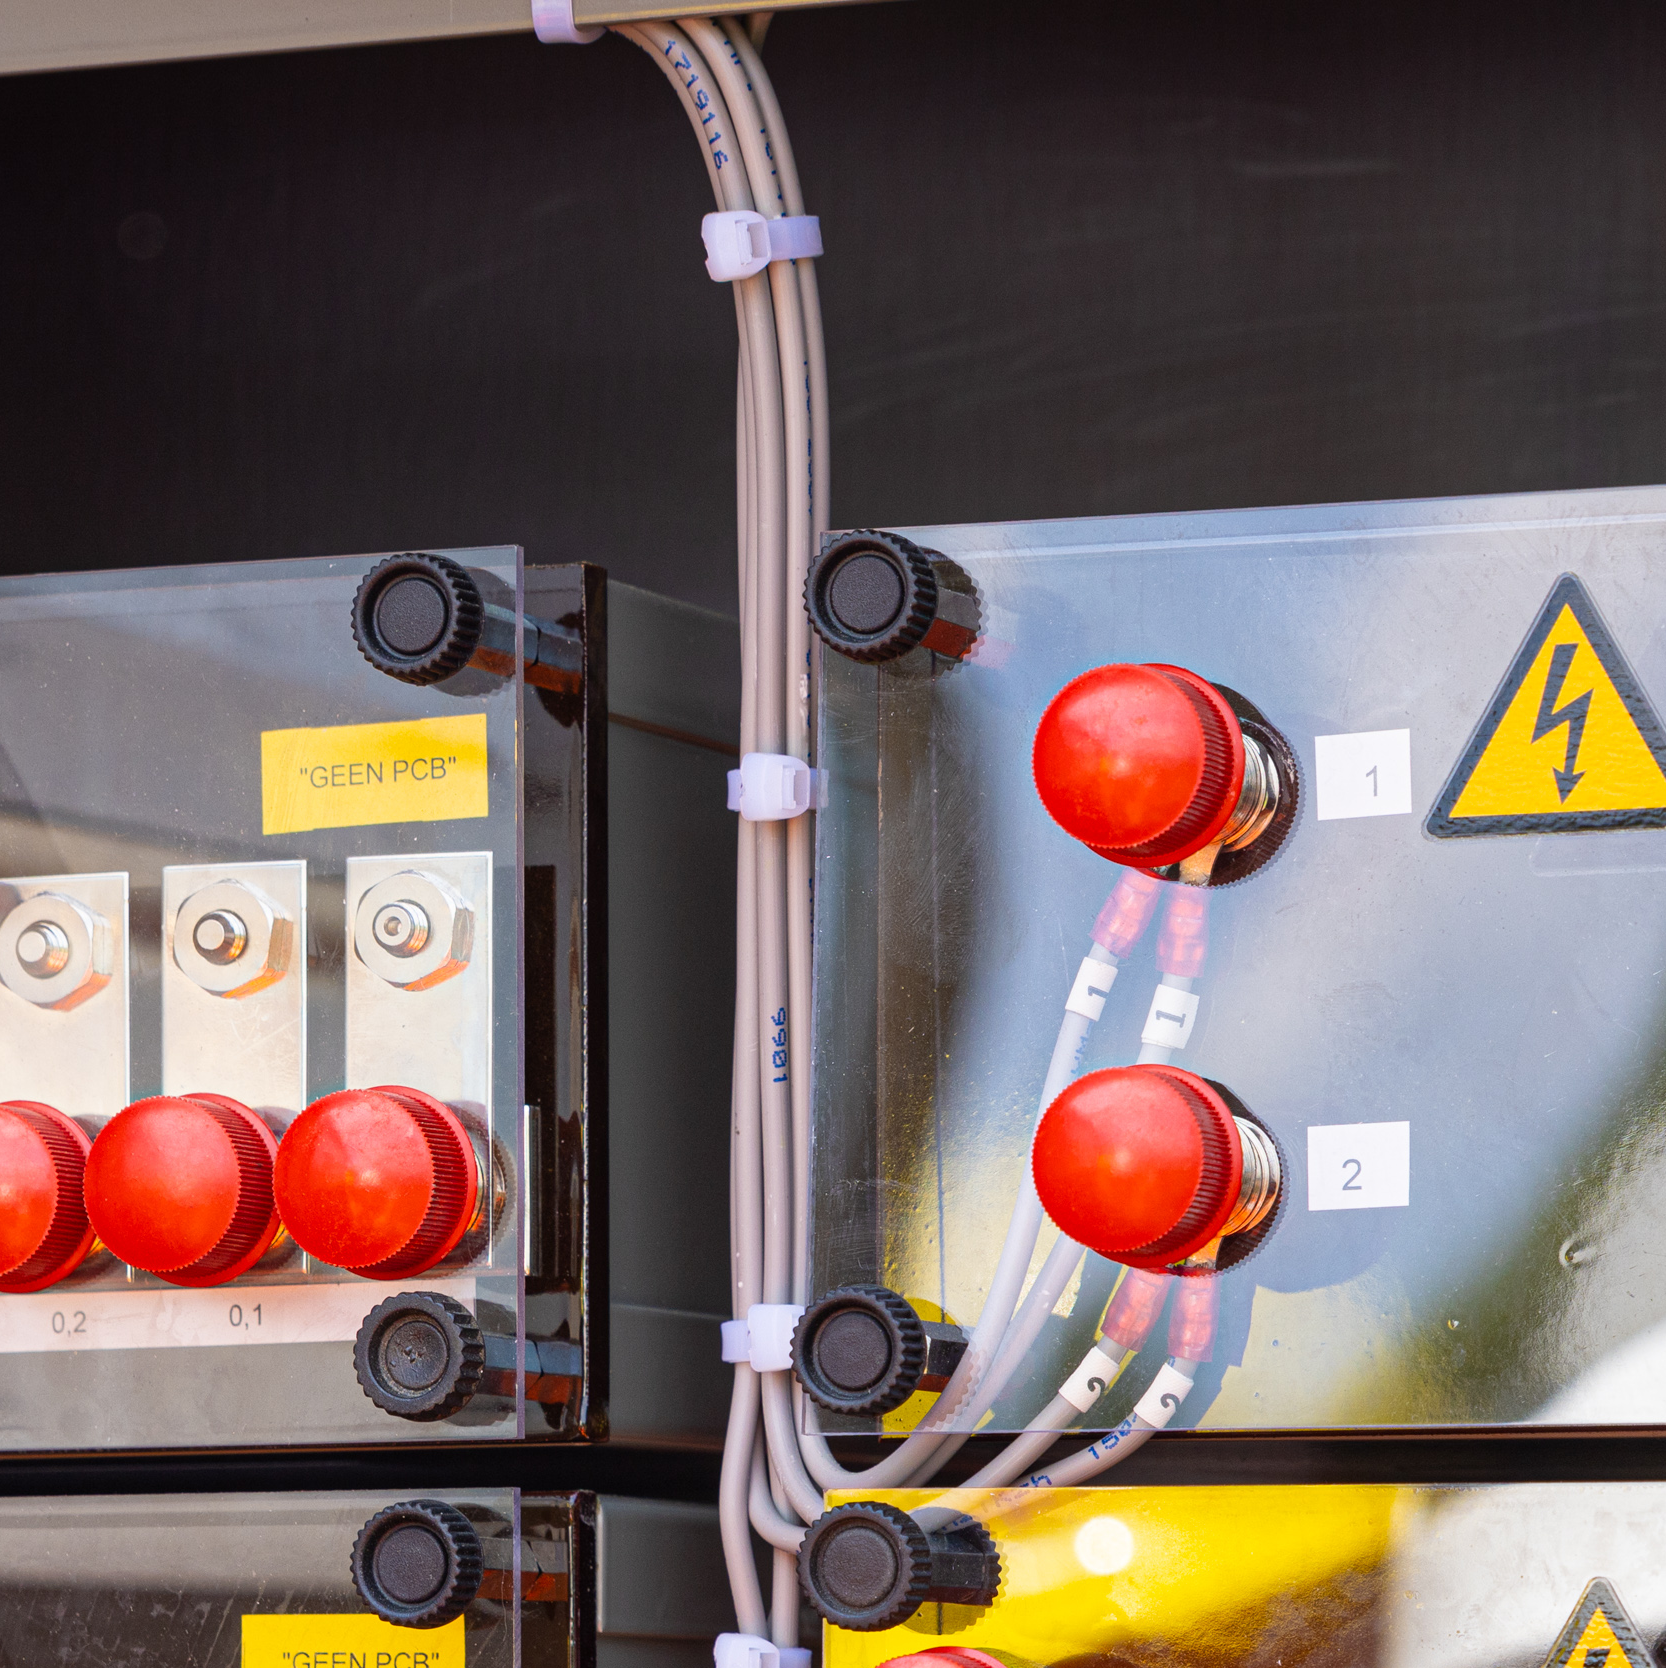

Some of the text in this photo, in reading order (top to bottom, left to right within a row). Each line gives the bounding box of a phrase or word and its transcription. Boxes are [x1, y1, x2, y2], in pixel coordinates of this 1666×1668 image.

[664, 40, 729, 171] 1719116
[299, 756, 457, 789] "GEEN PCB"
[1366, 766, 1379, 797] 1
[1156, 1008, 1186, 1028] 1
[1342, 1158, 1363, 1191] 2
[51, 1310, 87, 1336] 0,2
[229, 1304, 263, 1329] 0,1
